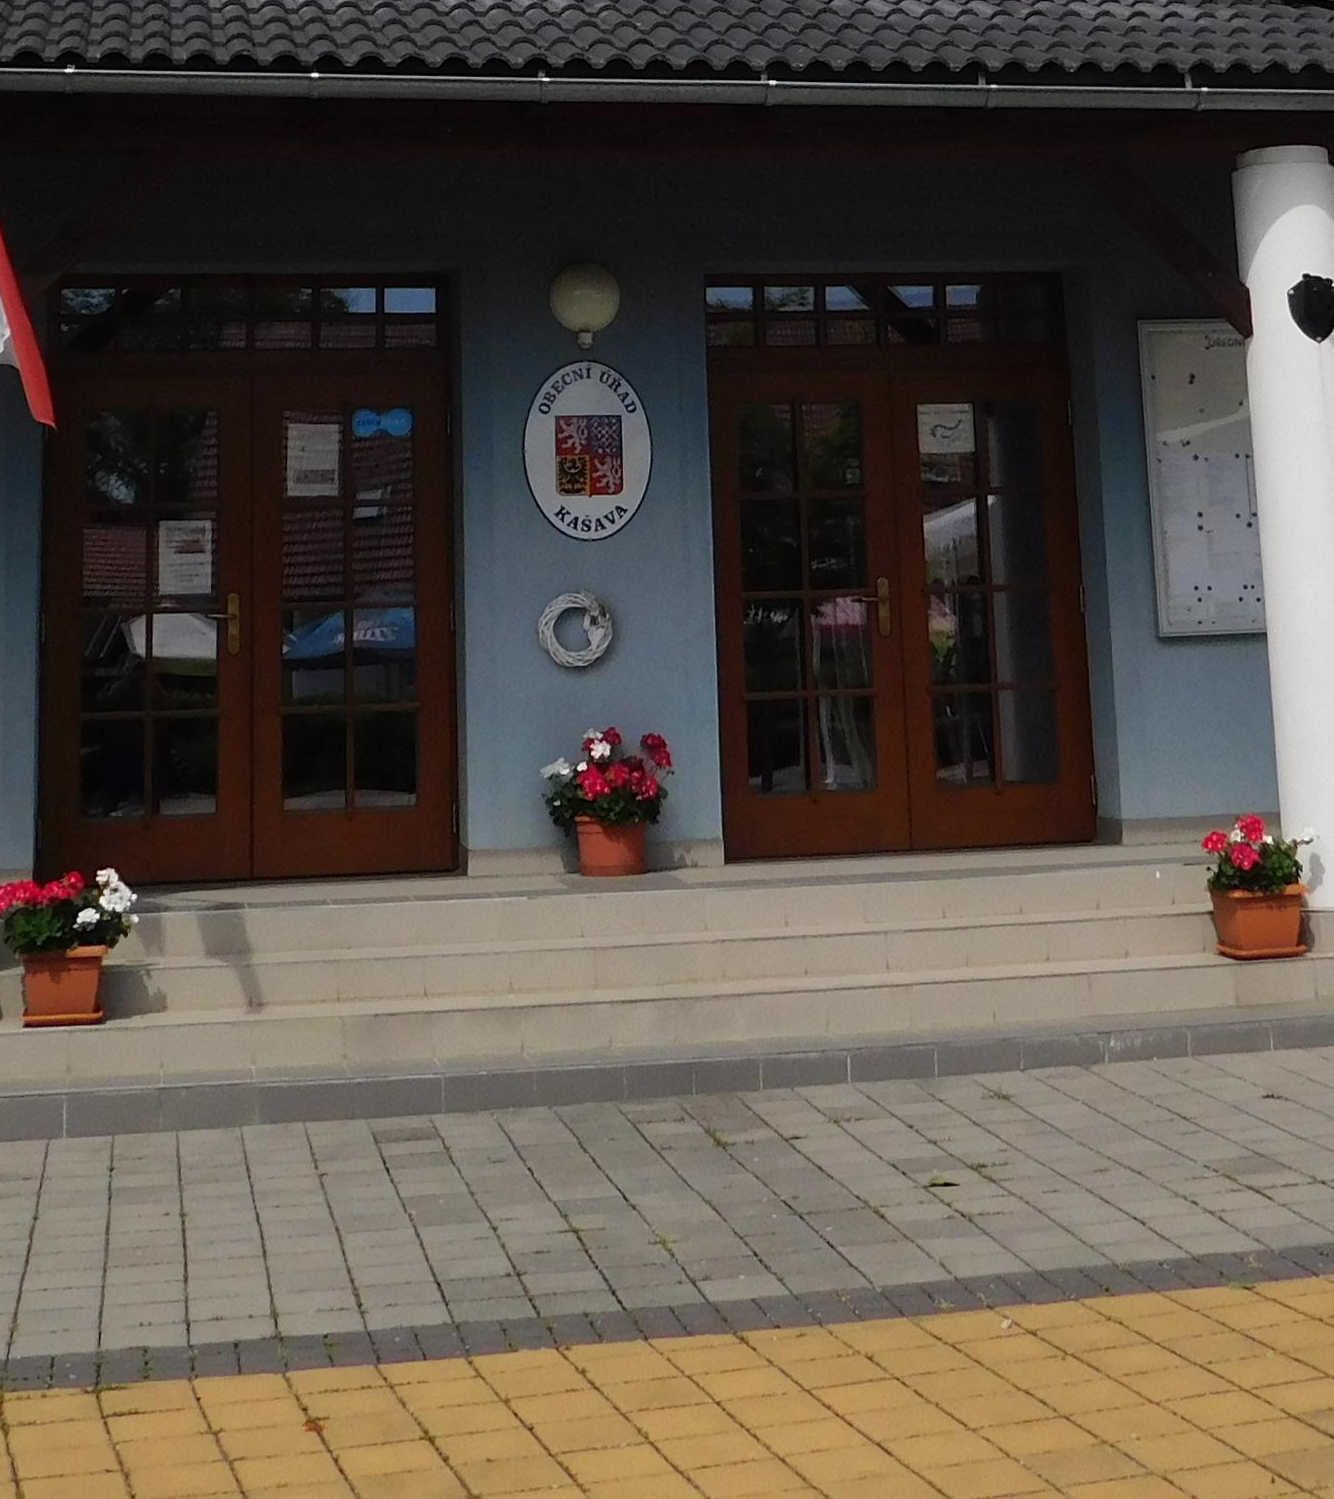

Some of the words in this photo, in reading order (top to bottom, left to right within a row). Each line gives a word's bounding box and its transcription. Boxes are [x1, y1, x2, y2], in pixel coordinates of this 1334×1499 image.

[538, 364, 593, 415] OBECNÍ
[599, 368, 638, 415] ÚŘAD
[553, 504, 629, 533] KAŠAVA
